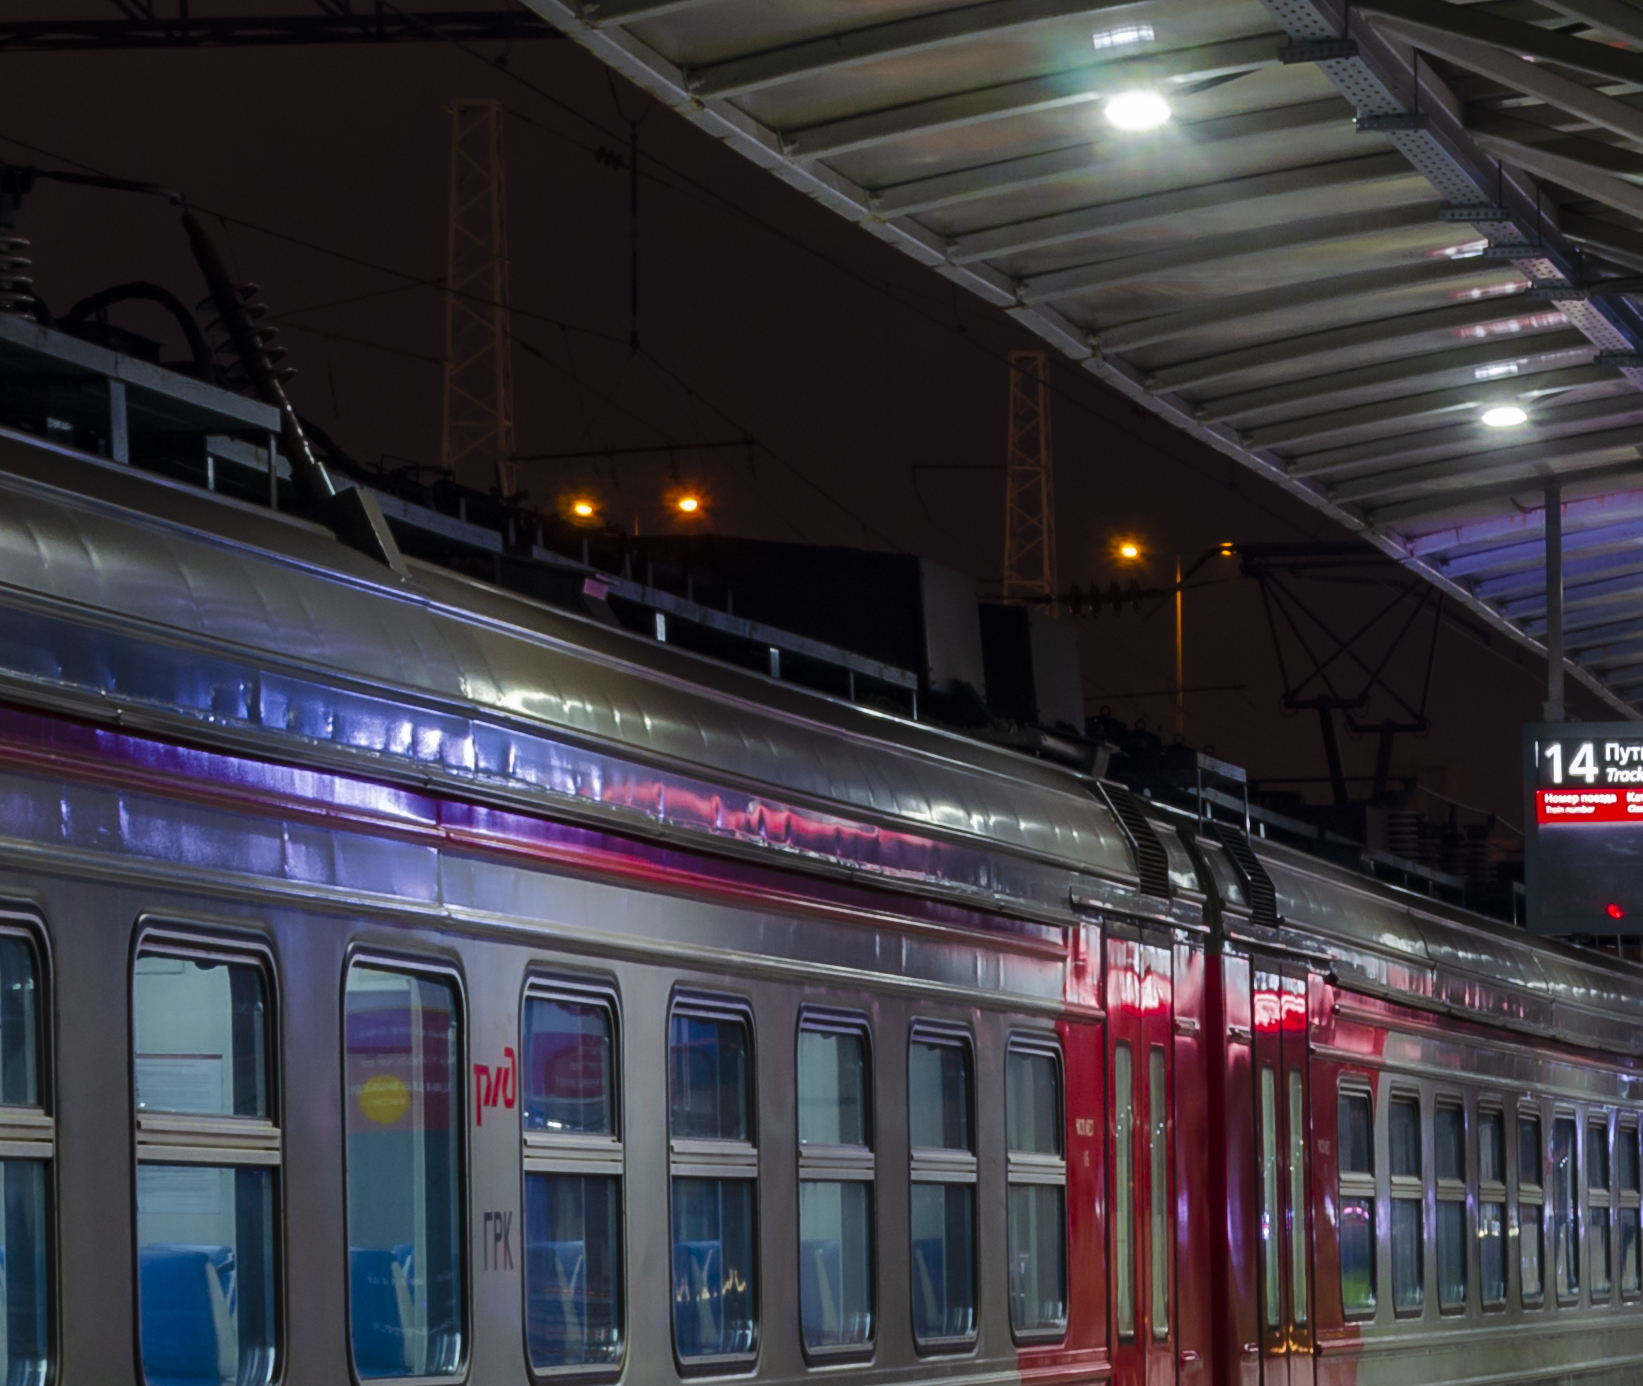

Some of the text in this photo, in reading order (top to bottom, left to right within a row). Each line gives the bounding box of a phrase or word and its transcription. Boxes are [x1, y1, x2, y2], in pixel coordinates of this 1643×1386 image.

[1545, 743, 1598, 783] 14
[1544, 793, 1617, 805] Номер поезда
[483, 1211, 513, 1271] ГРК
